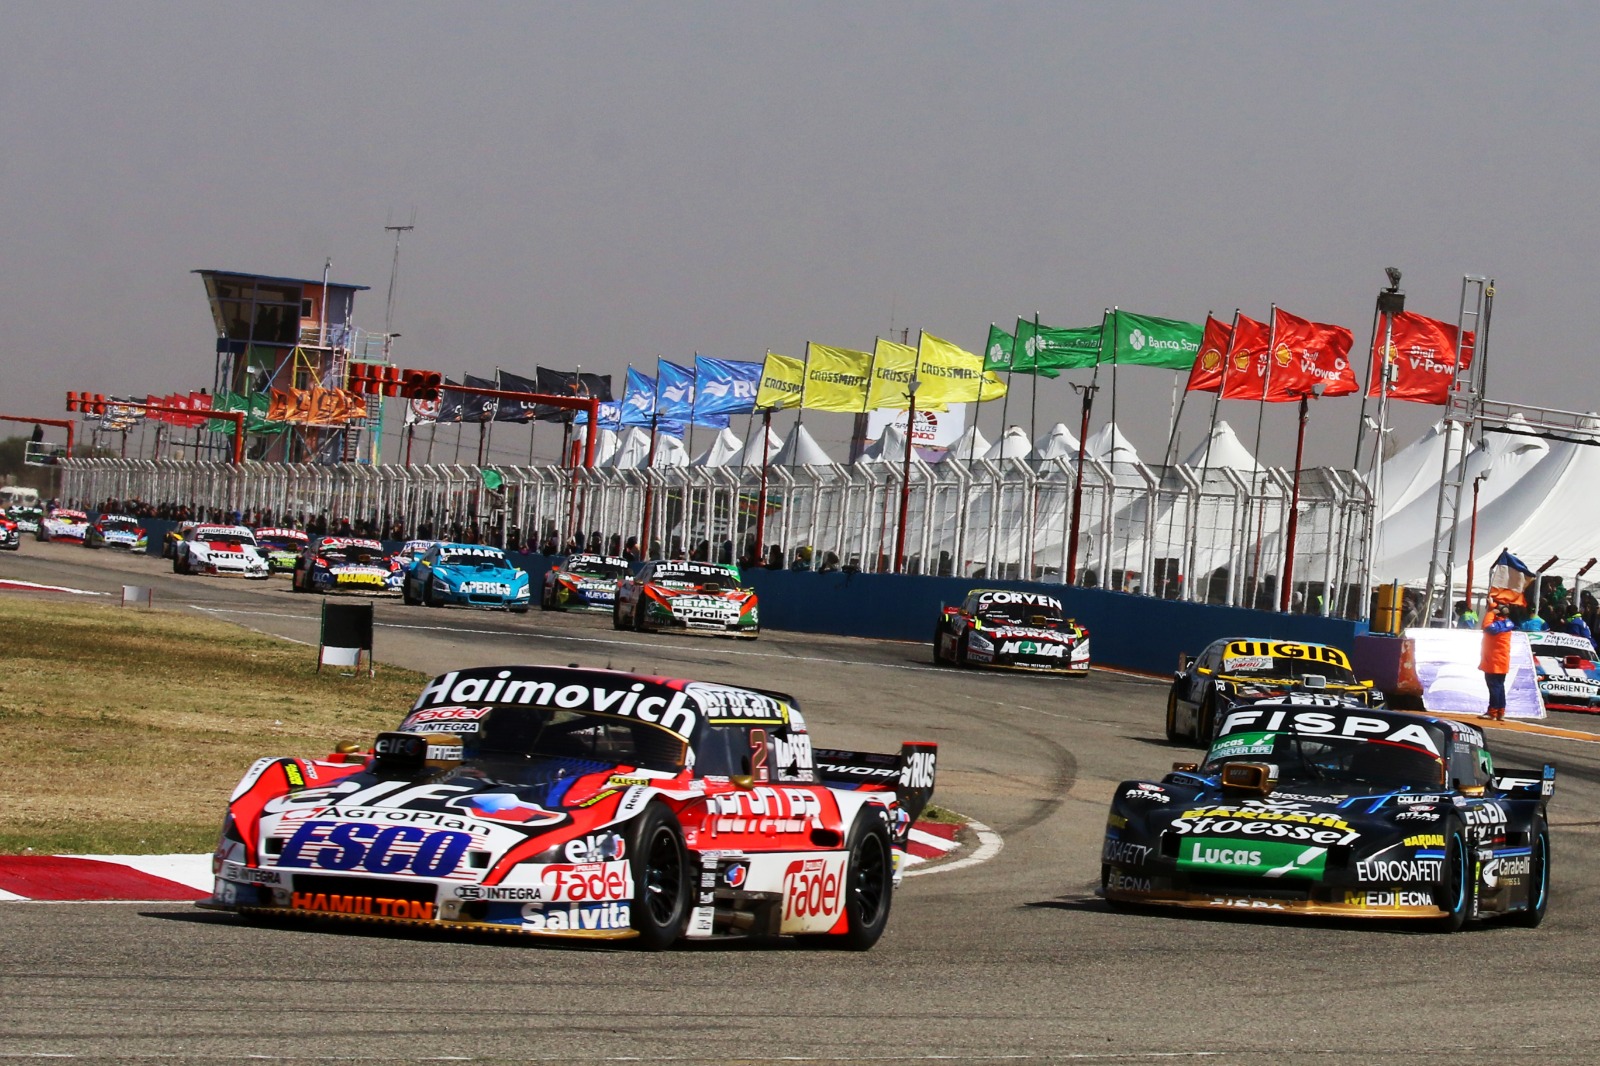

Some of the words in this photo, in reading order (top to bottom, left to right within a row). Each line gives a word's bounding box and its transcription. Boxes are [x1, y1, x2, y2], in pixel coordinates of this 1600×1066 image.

[1149, 336, 1179, 349] Banco
[440, 547, 506, 559] LIMART
[580, 554, 603, 564] DEL
[604, 556, 628, 568] SUR
[655, 561, 738, 577] philagro
[459, 580, 512, 596] APERSEG
[672, 598, 742, 611] METALFOR
[979, 591, 1063, 611] CORVEN
[682, 608, 730, 620] Prialis
[1546, 634, 1591, 646] PREVISORA
[1541, 683, 1597, 695] CORRIENTES
[413, 670, 697, 739] Haimovich
[422, 723, 478, 731] INTEGRA
[1218, 710, 1441, 758] FISPA
[1212, 738, 1244, 752] Lucas
[1126, 788, 1171, 803] ATLAS
[1180, 808, 1357, 834] BARDAHL
[1170, 816, 1362, 847] Stoessel
[276, 820, 474, 879] ESCO
[1403, 833, 1446, 850] BARDAHL
[1191, 841, 1262, 867] Lucas
[1355, 860, 1443, 882] EUROSAFETY
[1499, 857, 1531, 876] Carabelli
[541, 860, 628, 902] Fadel
[783, 859, 846, 921] Fadel
[487, 886, 542, 900] INTEGRA
[1344, 886, 1434, 909] MEDITECNA
[290, 890, 434, 920] HAMILTON
[521, 901, 631, 931] Salvita
